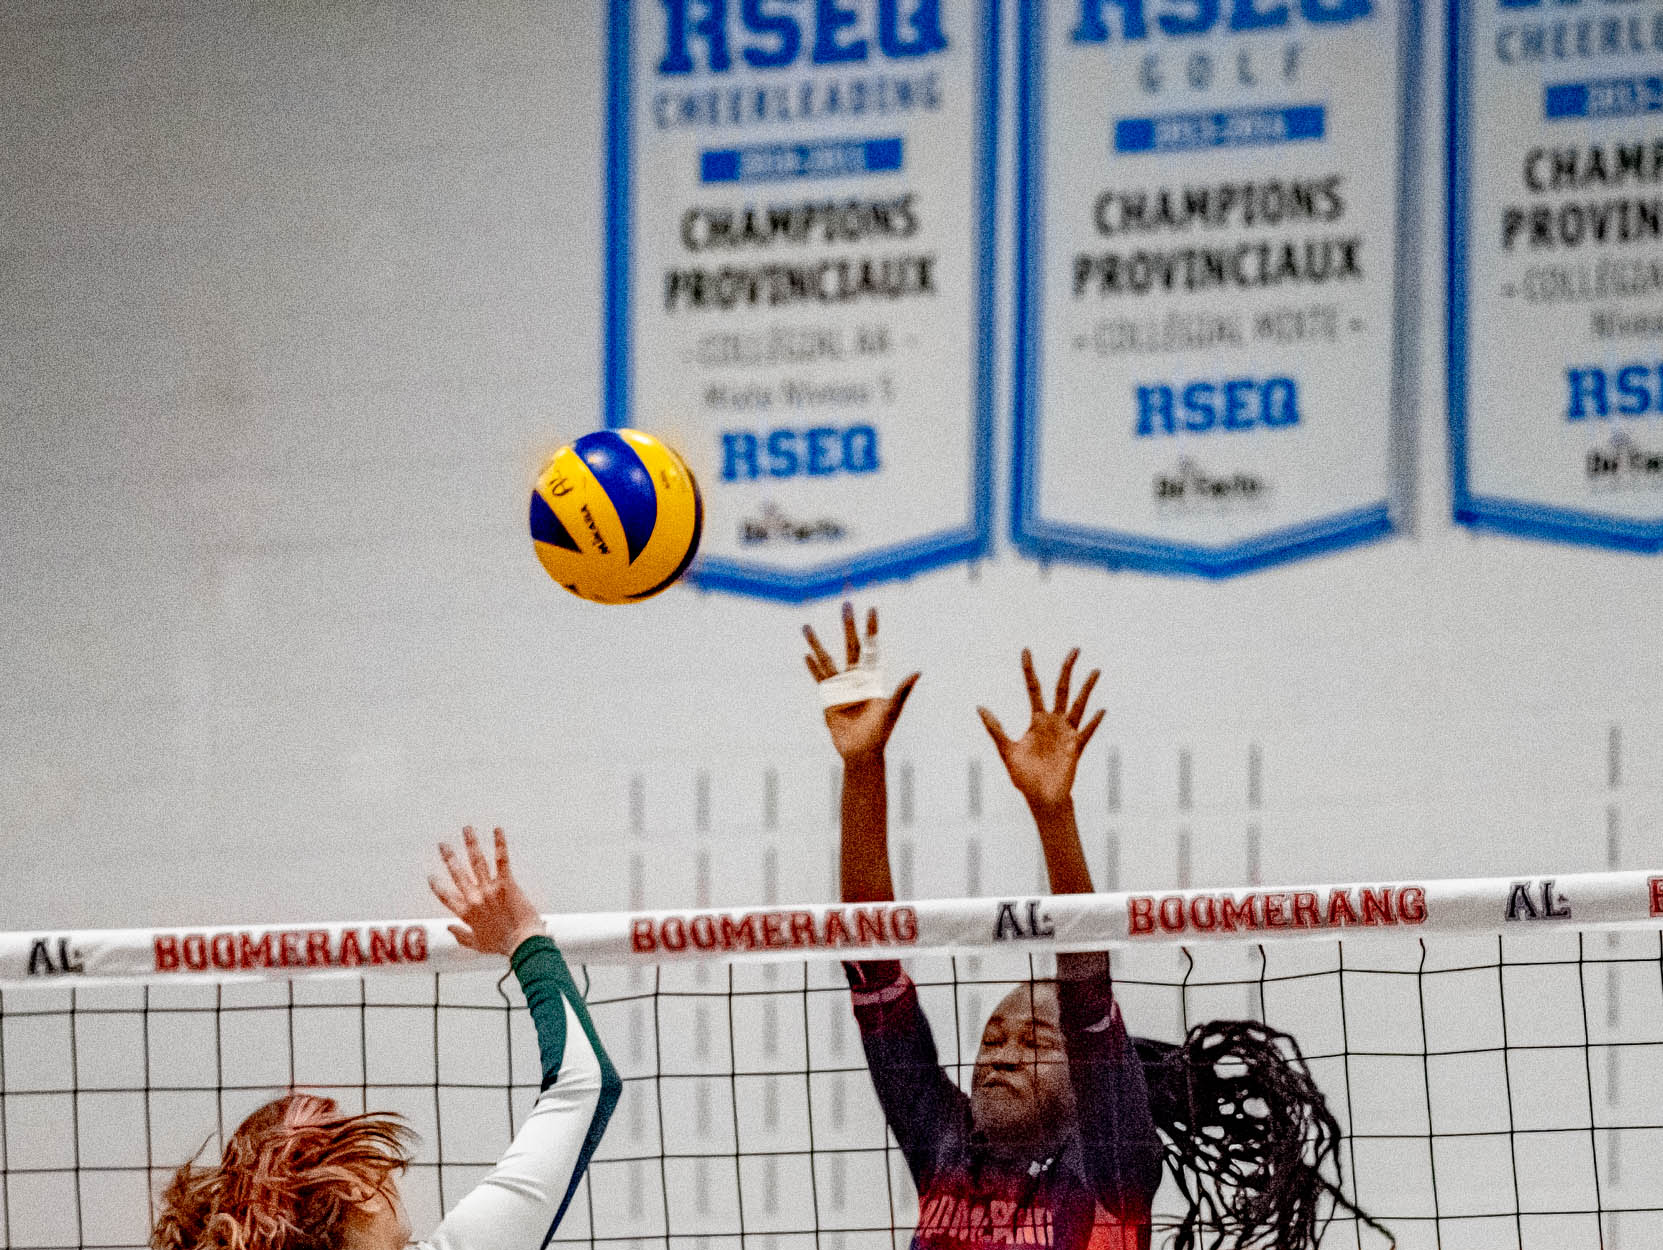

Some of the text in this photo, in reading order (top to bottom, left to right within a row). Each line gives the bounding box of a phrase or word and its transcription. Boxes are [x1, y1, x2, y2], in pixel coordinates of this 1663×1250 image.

[657, 0, 948, 74] RSEQ
[1139, 42, 1301, 93] GOLF
[652, 71, 942, 130] CHEERLEADING
[680, 193, 920, 252] CHAMPIONS
[1094, 174, 1345, 237] CHAMPIONS
[664, 253, 939, 313] PROVINCIAUX
[1073, 237, 1364, 297] PROVINCIAUX
[1135, 377, 1302, 438] RSEQ
[1566, 362, 1663, 422] RS
[722, 424, 881, 482] RSEQ
[153, 925, 429, 973] BOOMERANG
[629, 905, 919, 954] BOOMERANG
[1128, 884, 1428, 937] BOOMERANG
